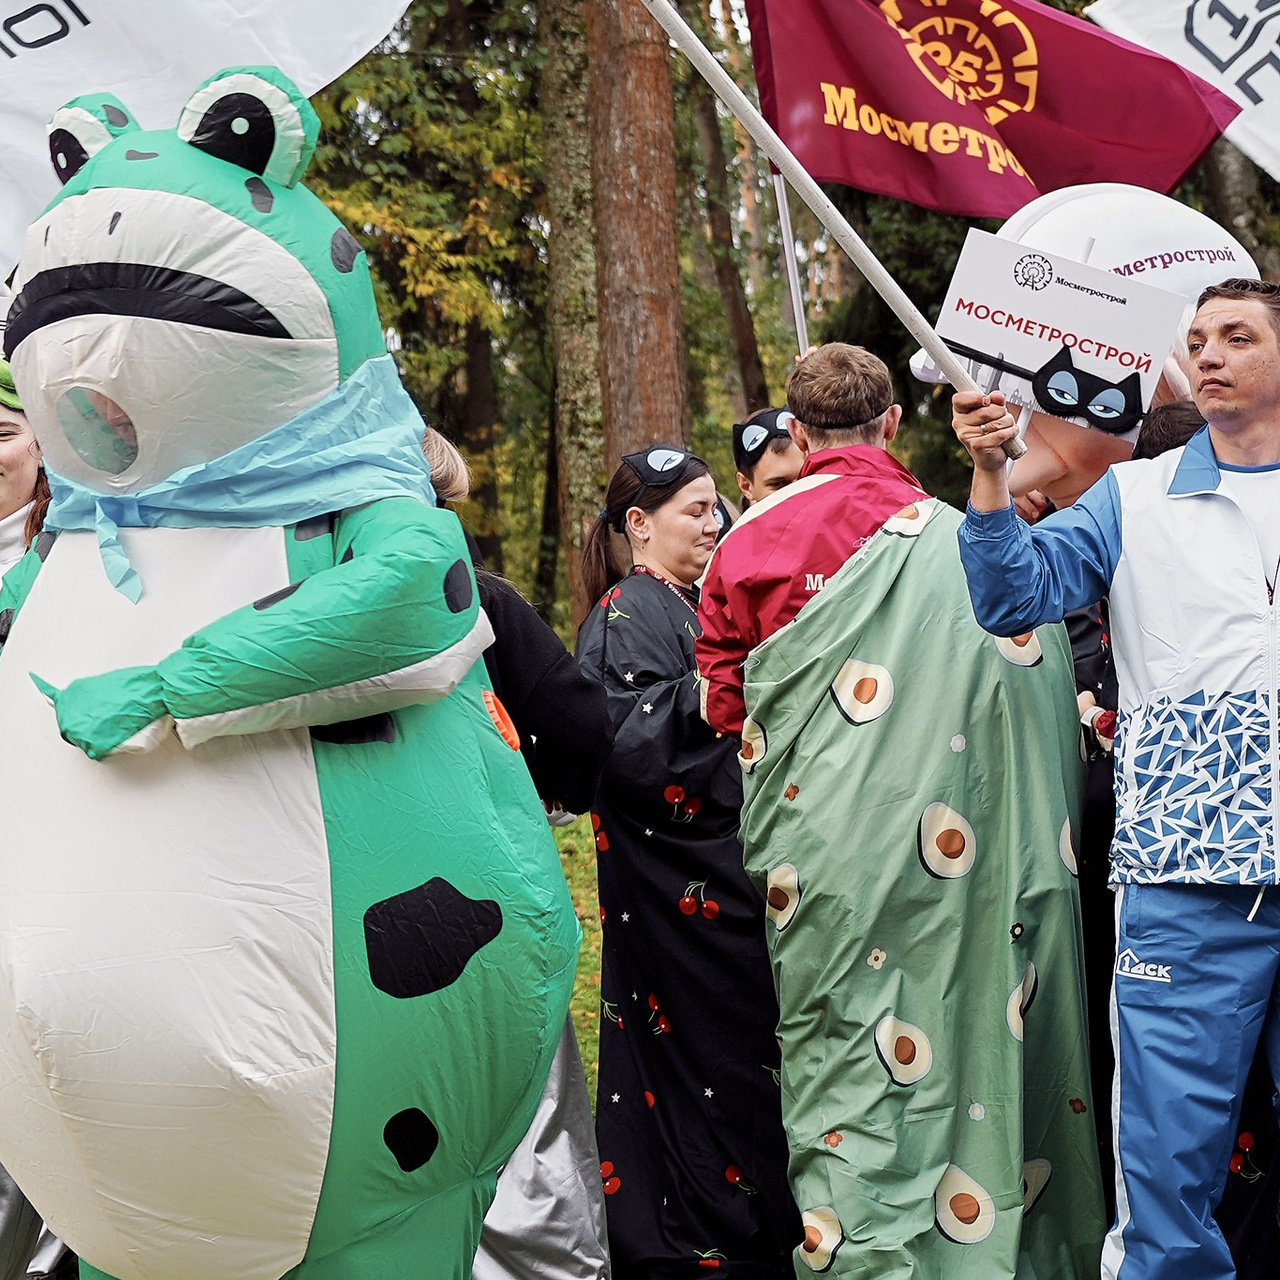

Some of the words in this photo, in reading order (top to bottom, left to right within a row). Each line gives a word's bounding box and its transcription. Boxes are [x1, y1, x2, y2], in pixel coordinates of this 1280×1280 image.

[1109, 246, 1236, 278] метрострой
[1055, 276, 1127, 305] Мосметрострой
[955, 297, 1153, 373] МОСМЕТРОСТРОЙ
